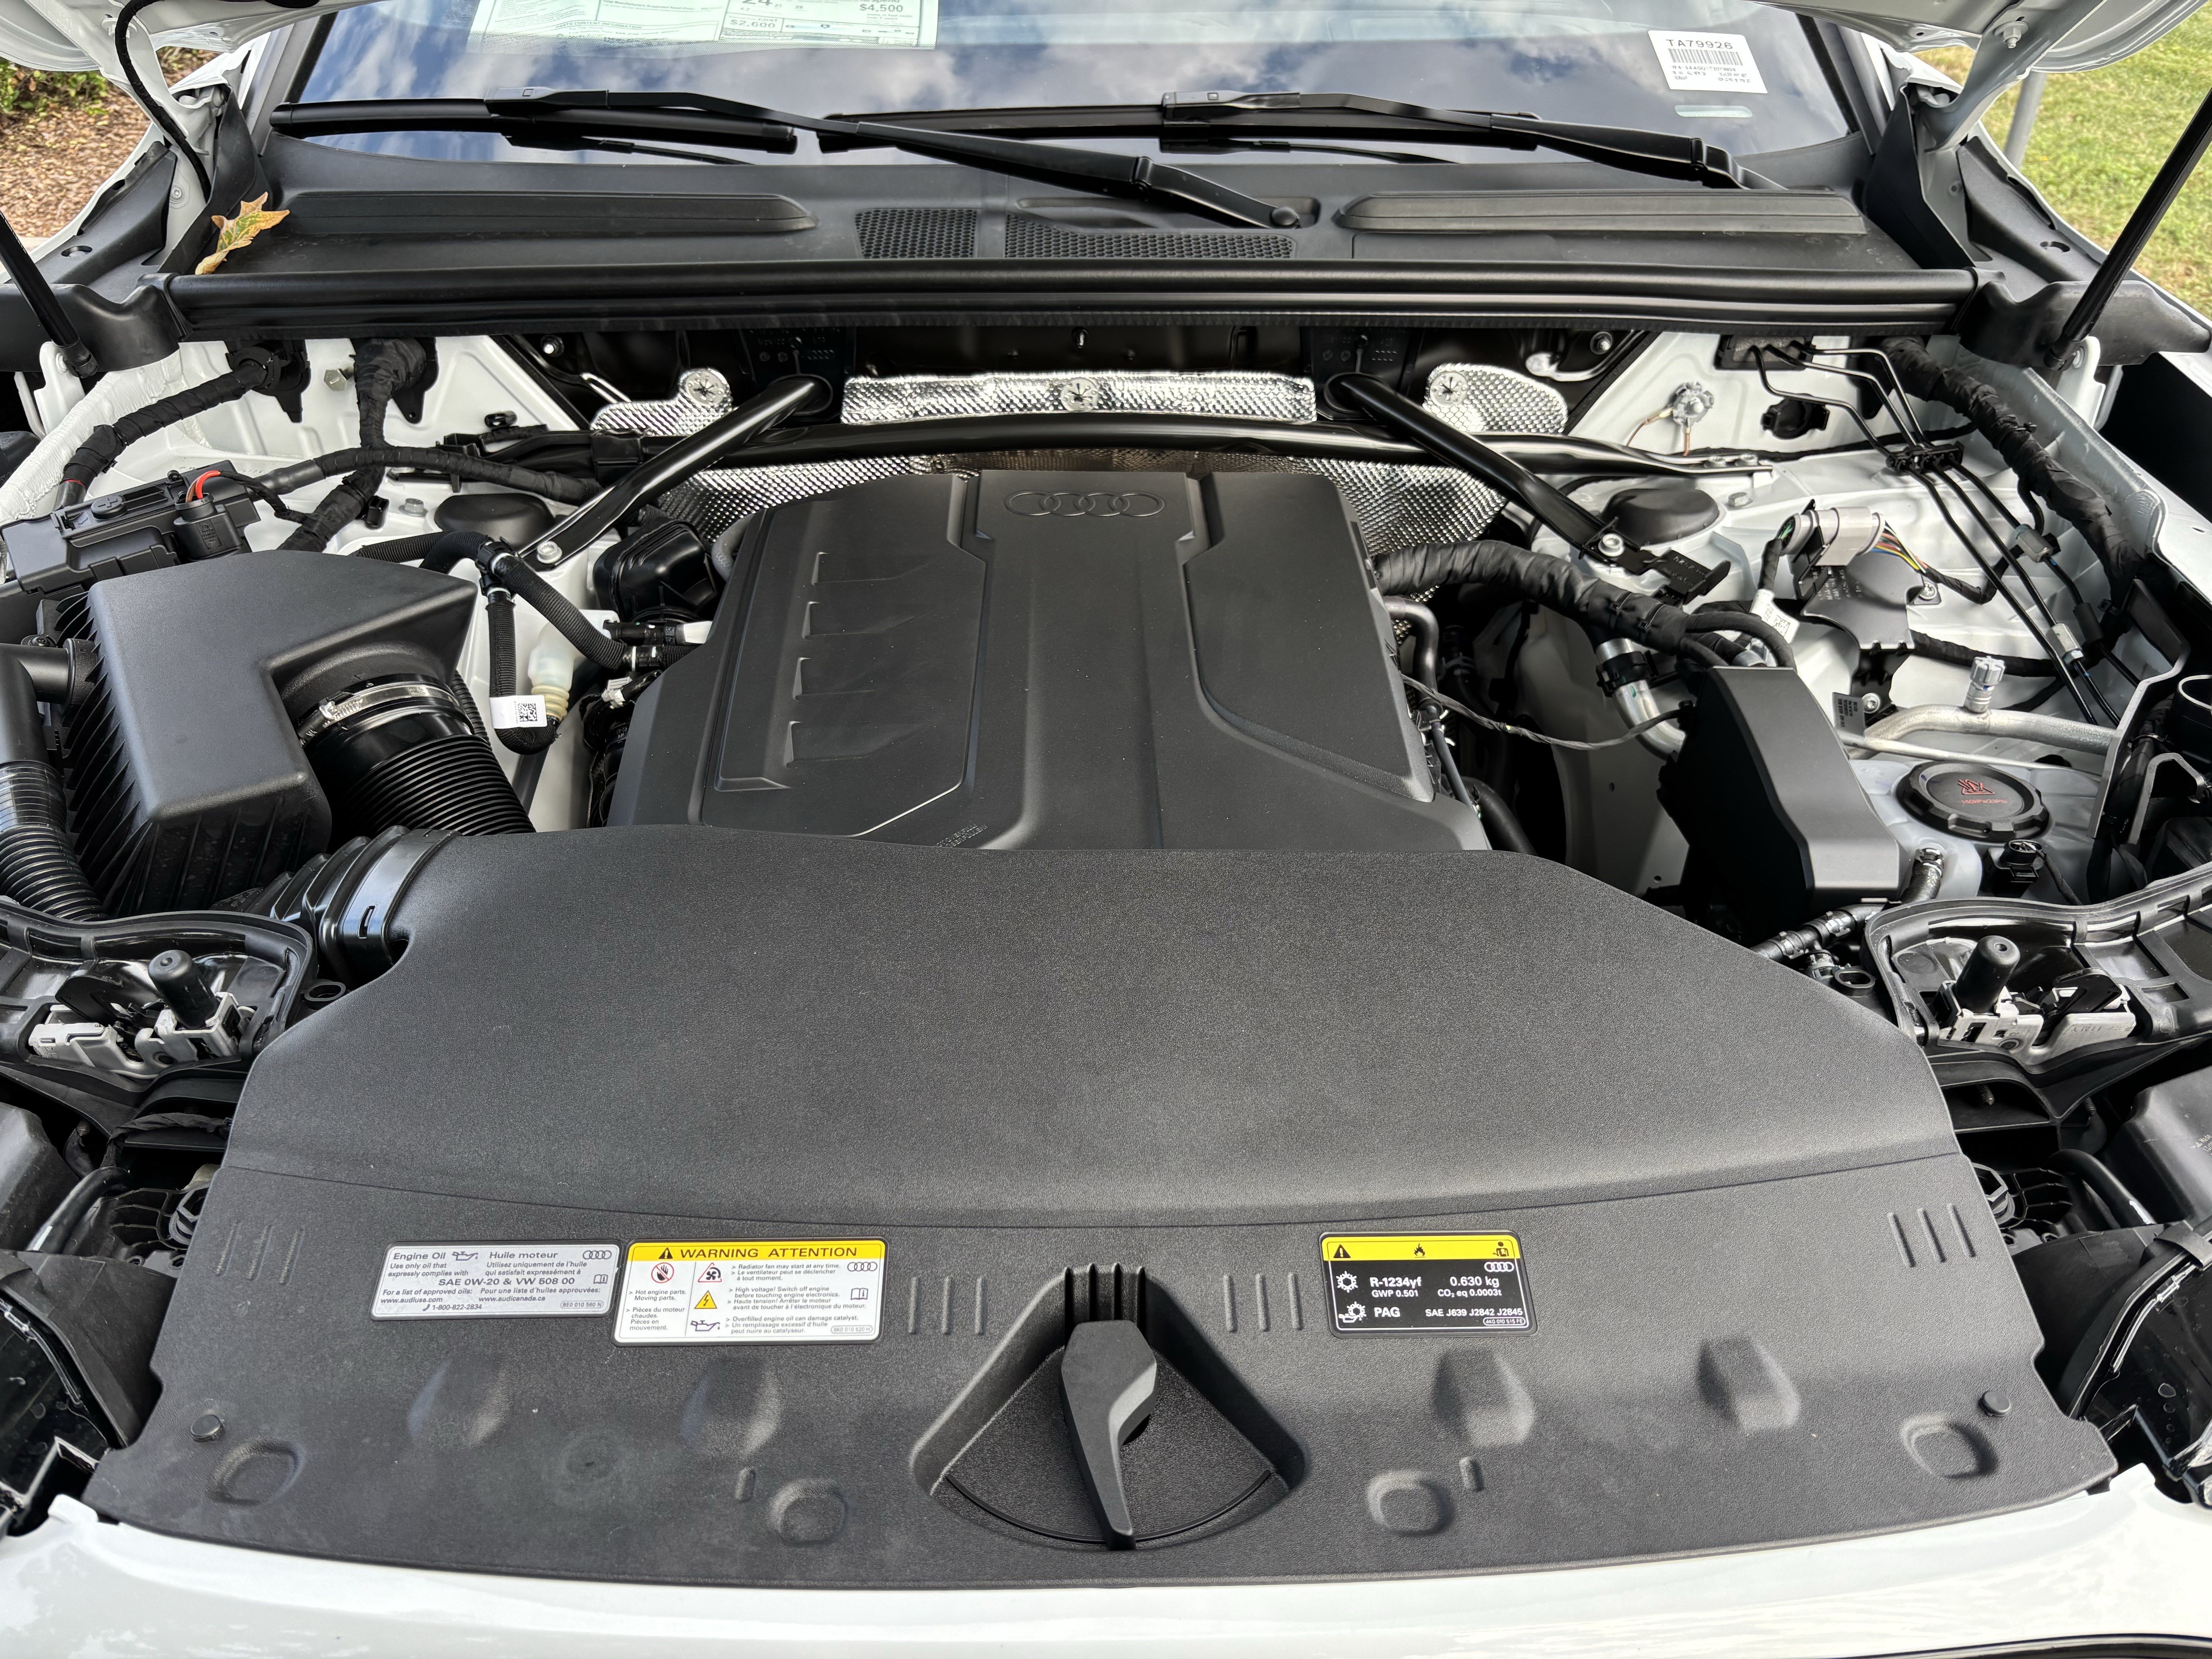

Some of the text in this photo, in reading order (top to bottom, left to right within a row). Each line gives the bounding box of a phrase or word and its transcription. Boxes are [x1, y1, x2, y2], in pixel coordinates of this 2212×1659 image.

[860, 3, 903, 12] $4,500
[730, 19, 776, 28] $2,600
[1666, 40, 1733, 49] TA79926
[681, 1248, 857, 1258] WARNING ATTENTION
[1370, 1277, 1421, 1288] R-1234yf
[1450, 1276, 1499, 1288] 0.630 kg
[1374, 1307, 1400, 1317] PAG
